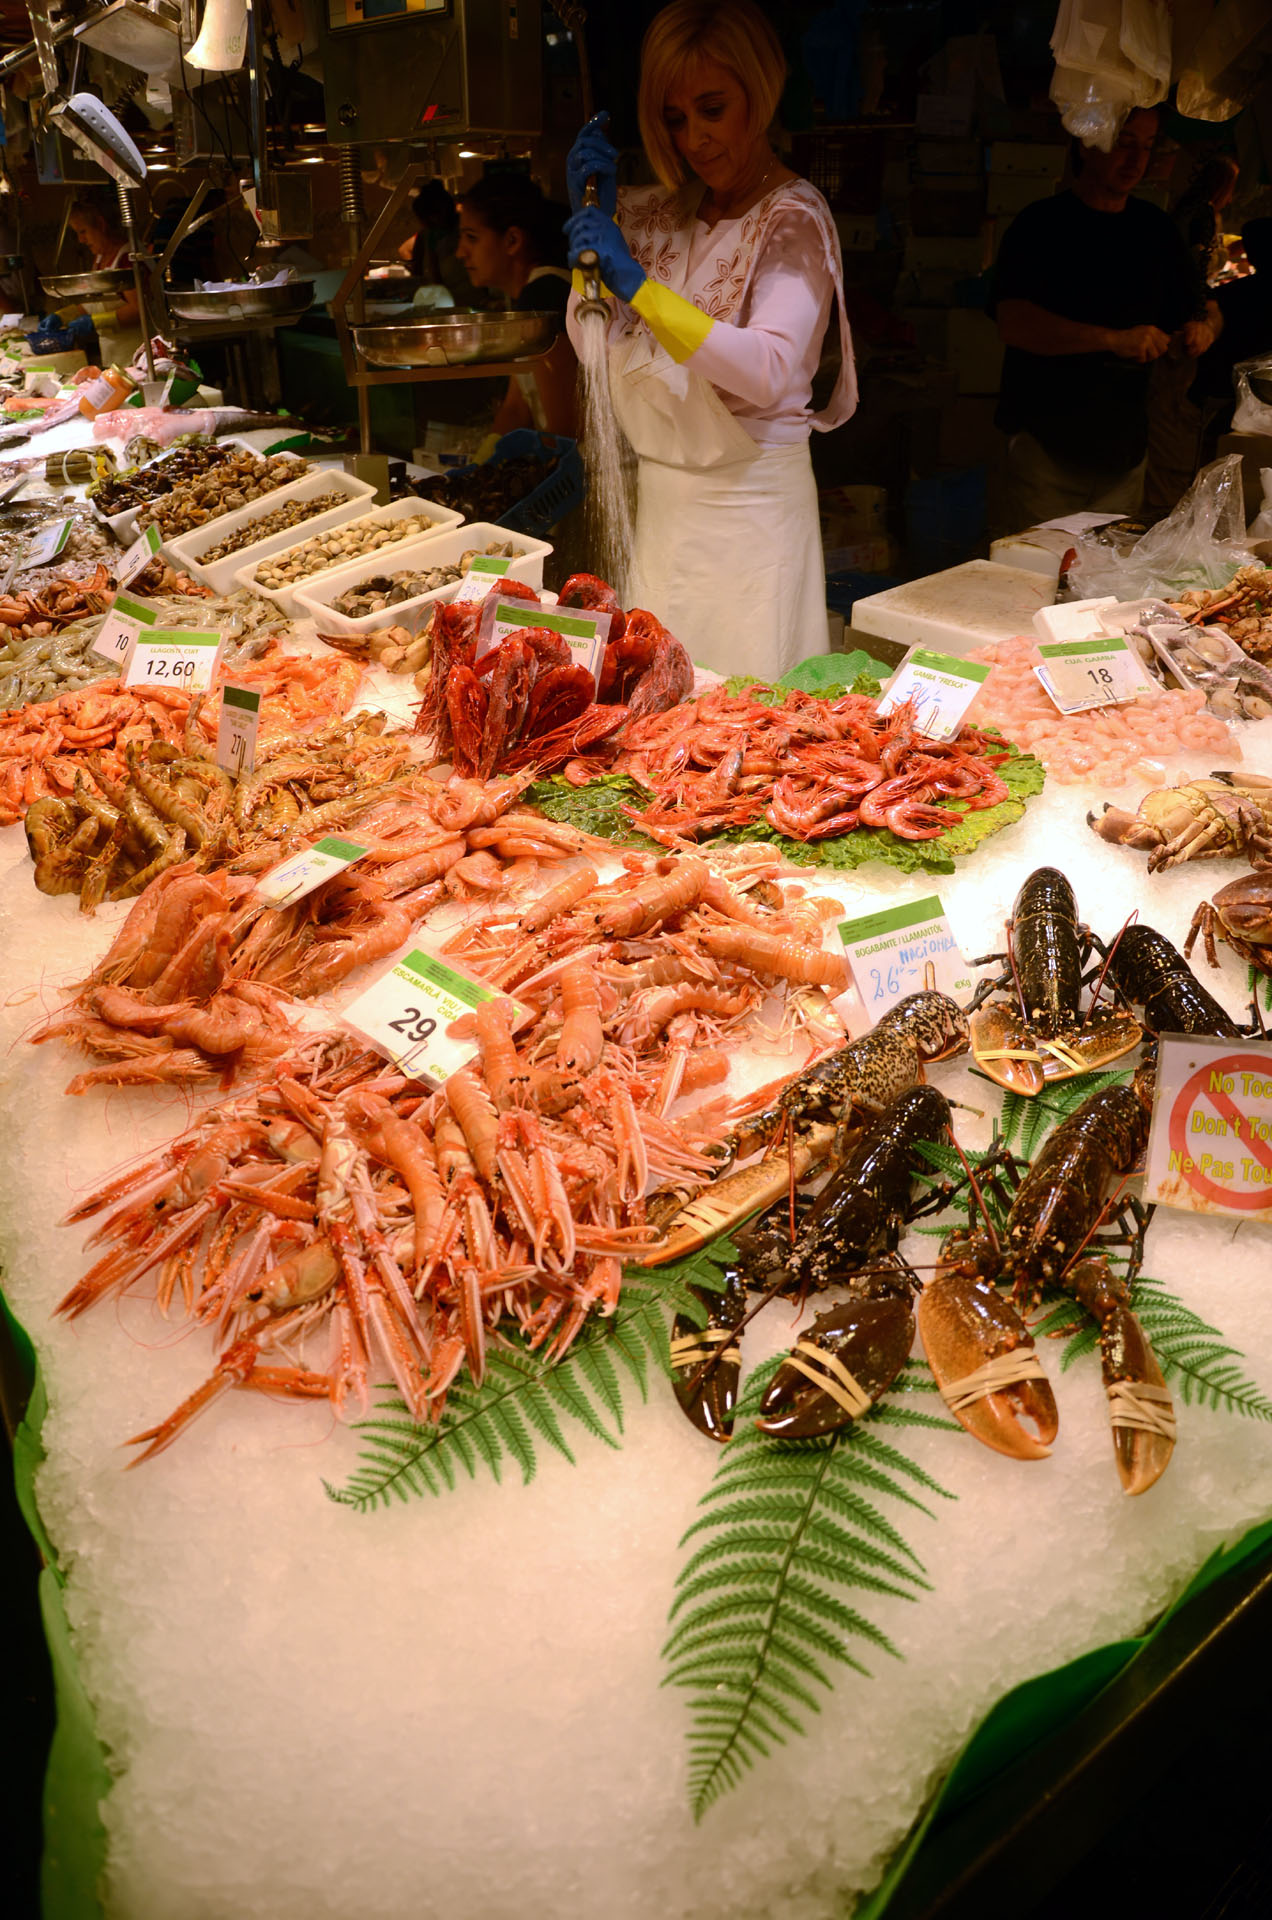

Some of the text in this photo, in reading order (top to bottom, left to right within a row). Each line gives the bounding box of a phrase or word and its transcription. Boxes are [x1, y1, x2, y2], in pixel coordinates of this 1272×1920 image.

[115, 633, 129, 651] 10
[567, 640, 588, 649] NERO
[1085, 655, 1117, 663] GAMBA
[146, 659, 196, 679] 12,60
[912, 669, 937, 683] GAMBA
[1087, 668, 1114, 685] 18
[854, 937, 898, 959] BOGABANTE
[436, 1005, 457, 1023] CIGA
[387, 1007, 437, 1042] 29
[1208, 1070, 1235, 1095] No
[1247, 1116, 1272, 1141] To
[1167, 1149, 1195, 1174] Ne
[1200, 1152, 1235, 1179] Pas
